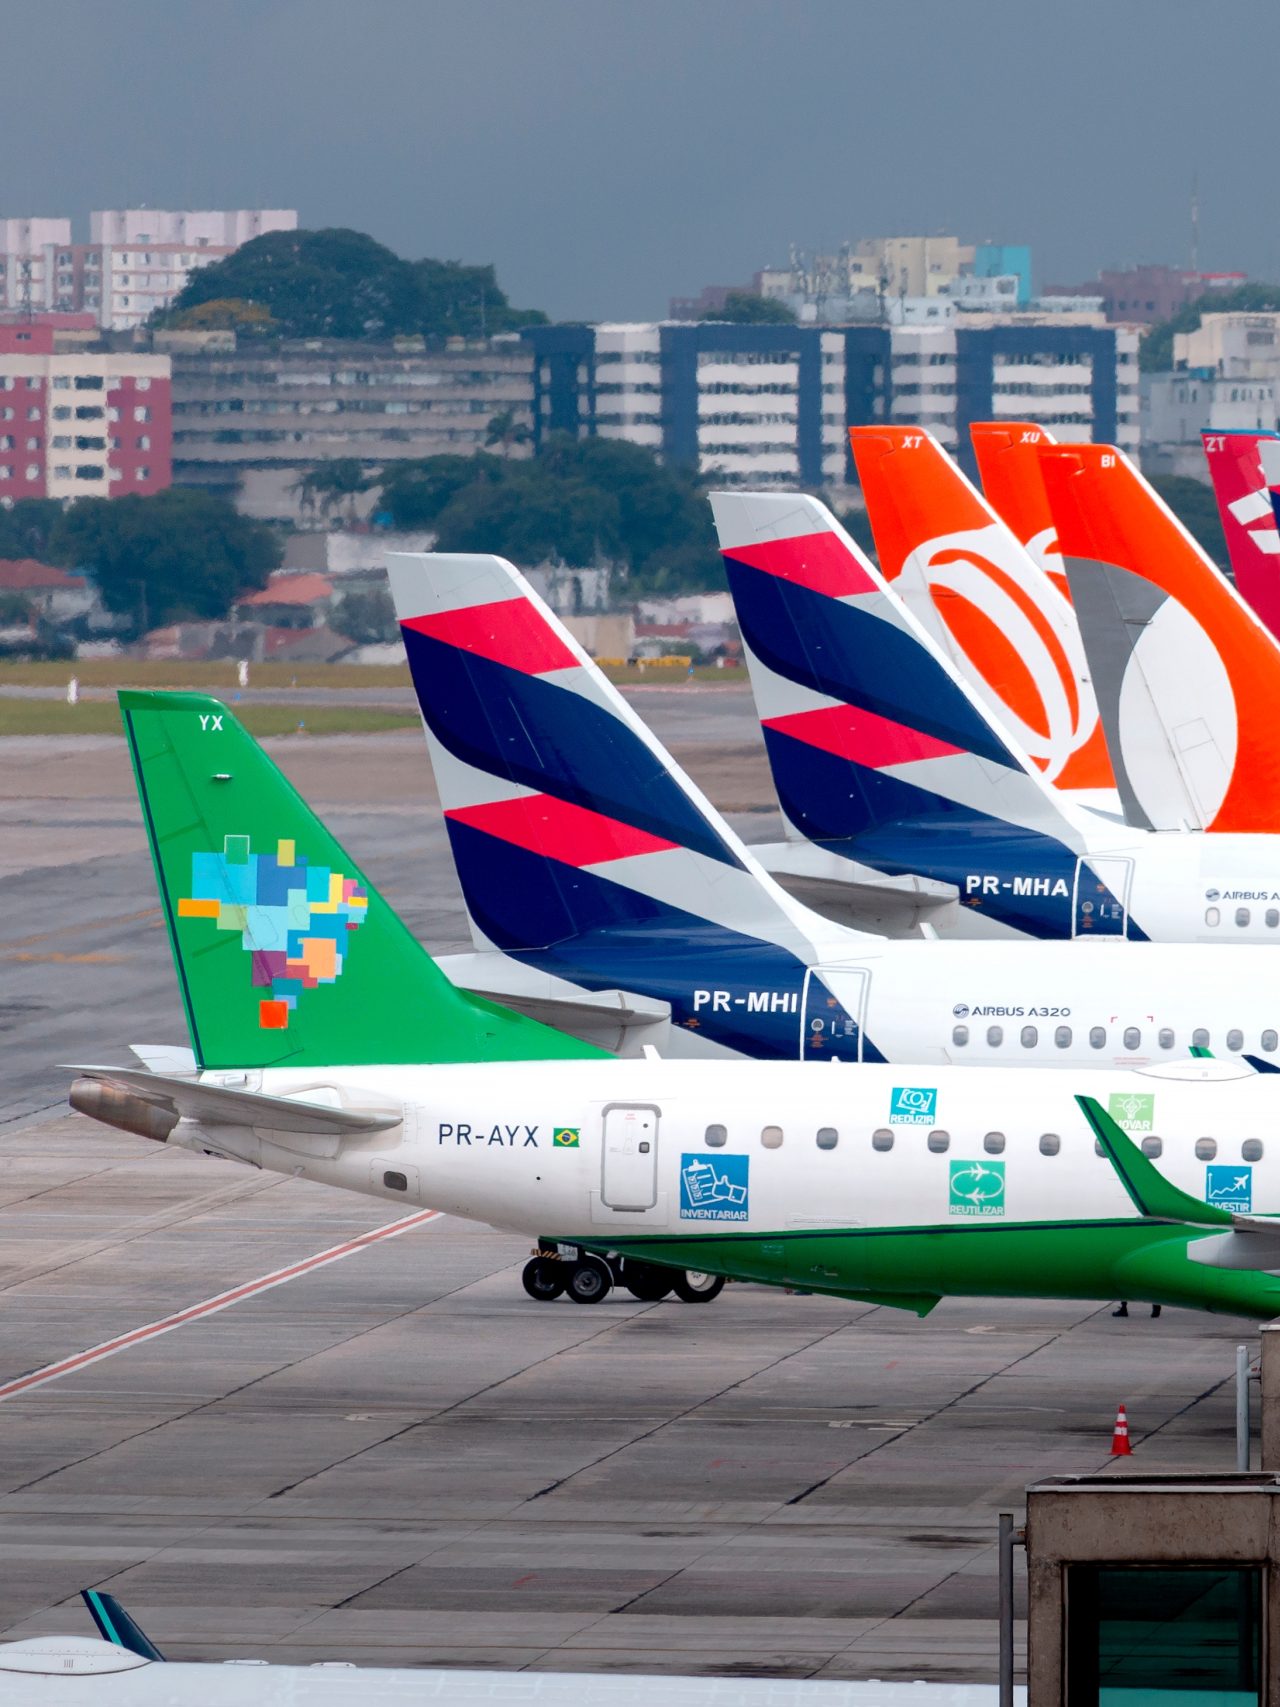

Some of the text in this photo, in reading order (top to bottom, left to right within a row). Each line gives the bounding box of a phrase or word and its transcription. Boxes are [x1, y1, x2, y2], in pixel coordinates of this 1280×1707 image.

[901, 435, 924, 449] XT
[1019, 431, 1041, 443] XU
[1204, 436, 1226, 452] ZT
[1101, 454, 1116, 468] BI
[198, 714, 223, 731] YX
[966, 875, 1069, 897] PR-MHA
[1222, 891, 1268, 901] AIRBUS
[693, 990, 798, 1013] PR-MHI
[972, 1006, 1071, 1017] AIRBUS A320
[890, 1114, 935, 1125] REDUZIR
[438, 1123, 540, 1148] PR-AYX
[681, 1209, 748, 1220] INVENTARIAR
[949, 1205, 1004, 1216] REUTILIZAR
